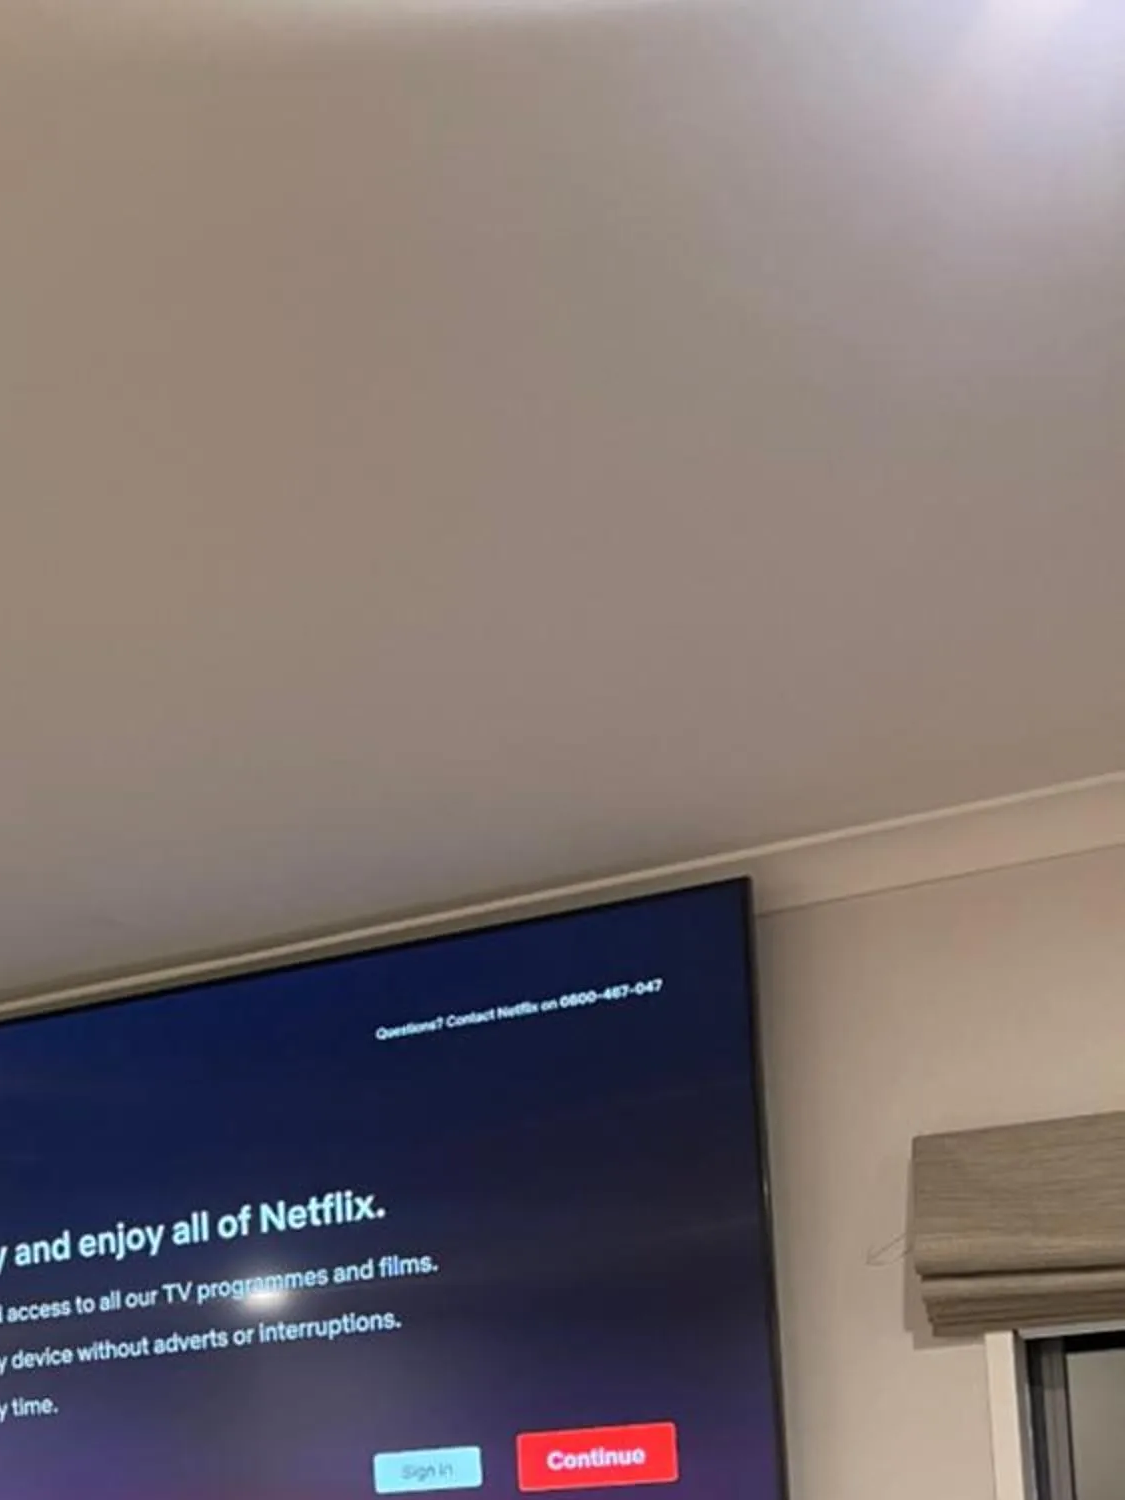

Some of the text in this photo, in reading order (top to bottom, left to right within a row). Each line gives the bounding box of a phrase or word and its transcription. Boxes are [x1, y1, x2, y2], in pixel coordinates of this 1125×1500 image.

[375, 1017, 444, 1040] Questions?
[446, 1006, 495, 1028] Contact
[497, 1001, 539, 1020] Netflix
[541, 1000, 557, 1012] on
[14, 1229, 71, 1266] and
[78, 1222, 165, 1260] enjoy
[172, 1210, 210, 1245] all
[217, 1204, 252, 1239] of
[259, 1190, 387, 1233] Netflix.
[7, 1299, 71, 1321] access
[76, 1296, 95, 1314] to
[99, 1290, 121, 1312] all
[125, 1291, 158, 1308] our
[161, 1281, 193, 1303] TV
[197, 1268, 328, 1303] programmes
[333, 1259, 375, 1283] and
[378, 1254, 439, 1279] films.
[11, 1347, 73, 1370] device
[77, 1336, 149, 1362] without
[154, 1329, 228, 1354] adverts
[233, 1328, 255, 1346] or
[258, 1312, 402, 1343] interruptions.
[11, 1396, 58, 1417] time.
[401, 1464, 436, 1482] Sign
[546, 1448, 646, 1471] Continue
